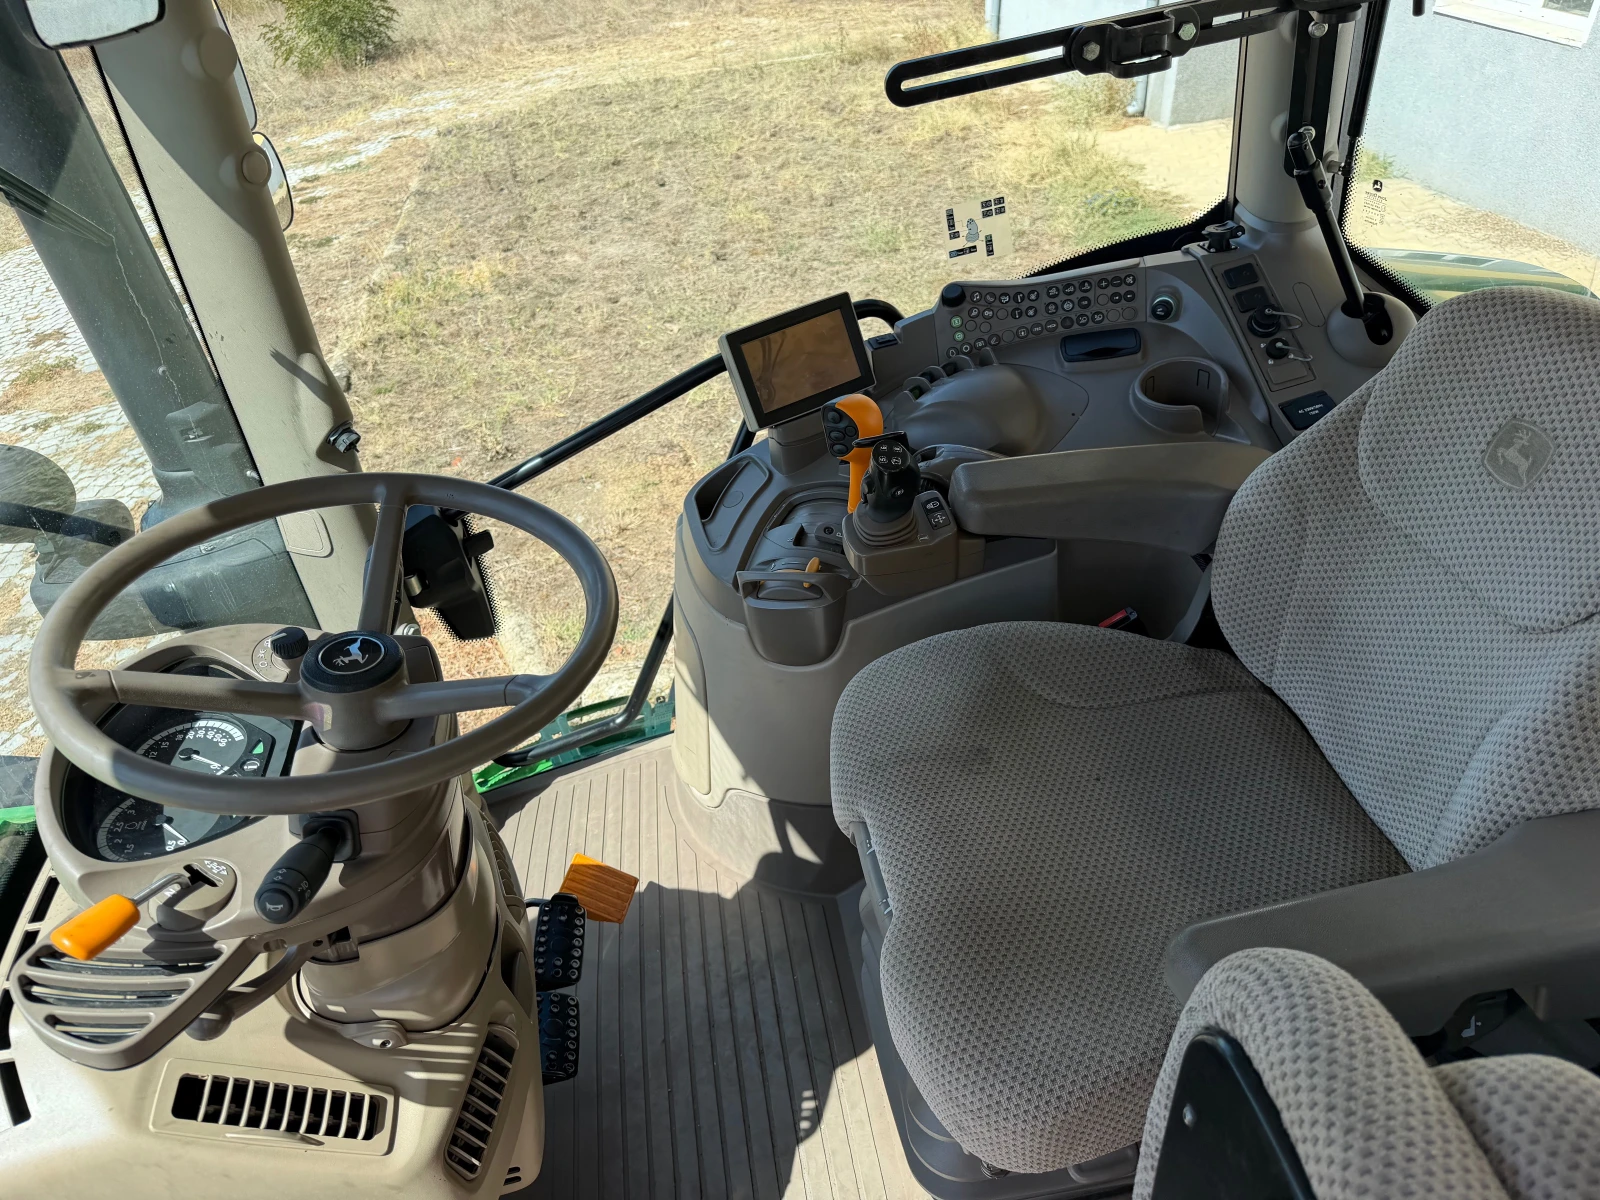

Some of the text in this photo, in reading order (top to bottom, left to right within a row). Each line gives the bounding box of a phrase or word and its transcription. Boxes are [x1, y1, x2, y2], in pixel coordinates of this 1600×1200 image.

[186, 731, 195, 740] 20
[196, 730, 206, 739] 30
[206, 731, 215, 740] 40
[212, 733, 222, 742] 50
[161, 741, 169, 749] 15
[218, 738, 228, 747] 60
[149, 751, 158, 759] 12
